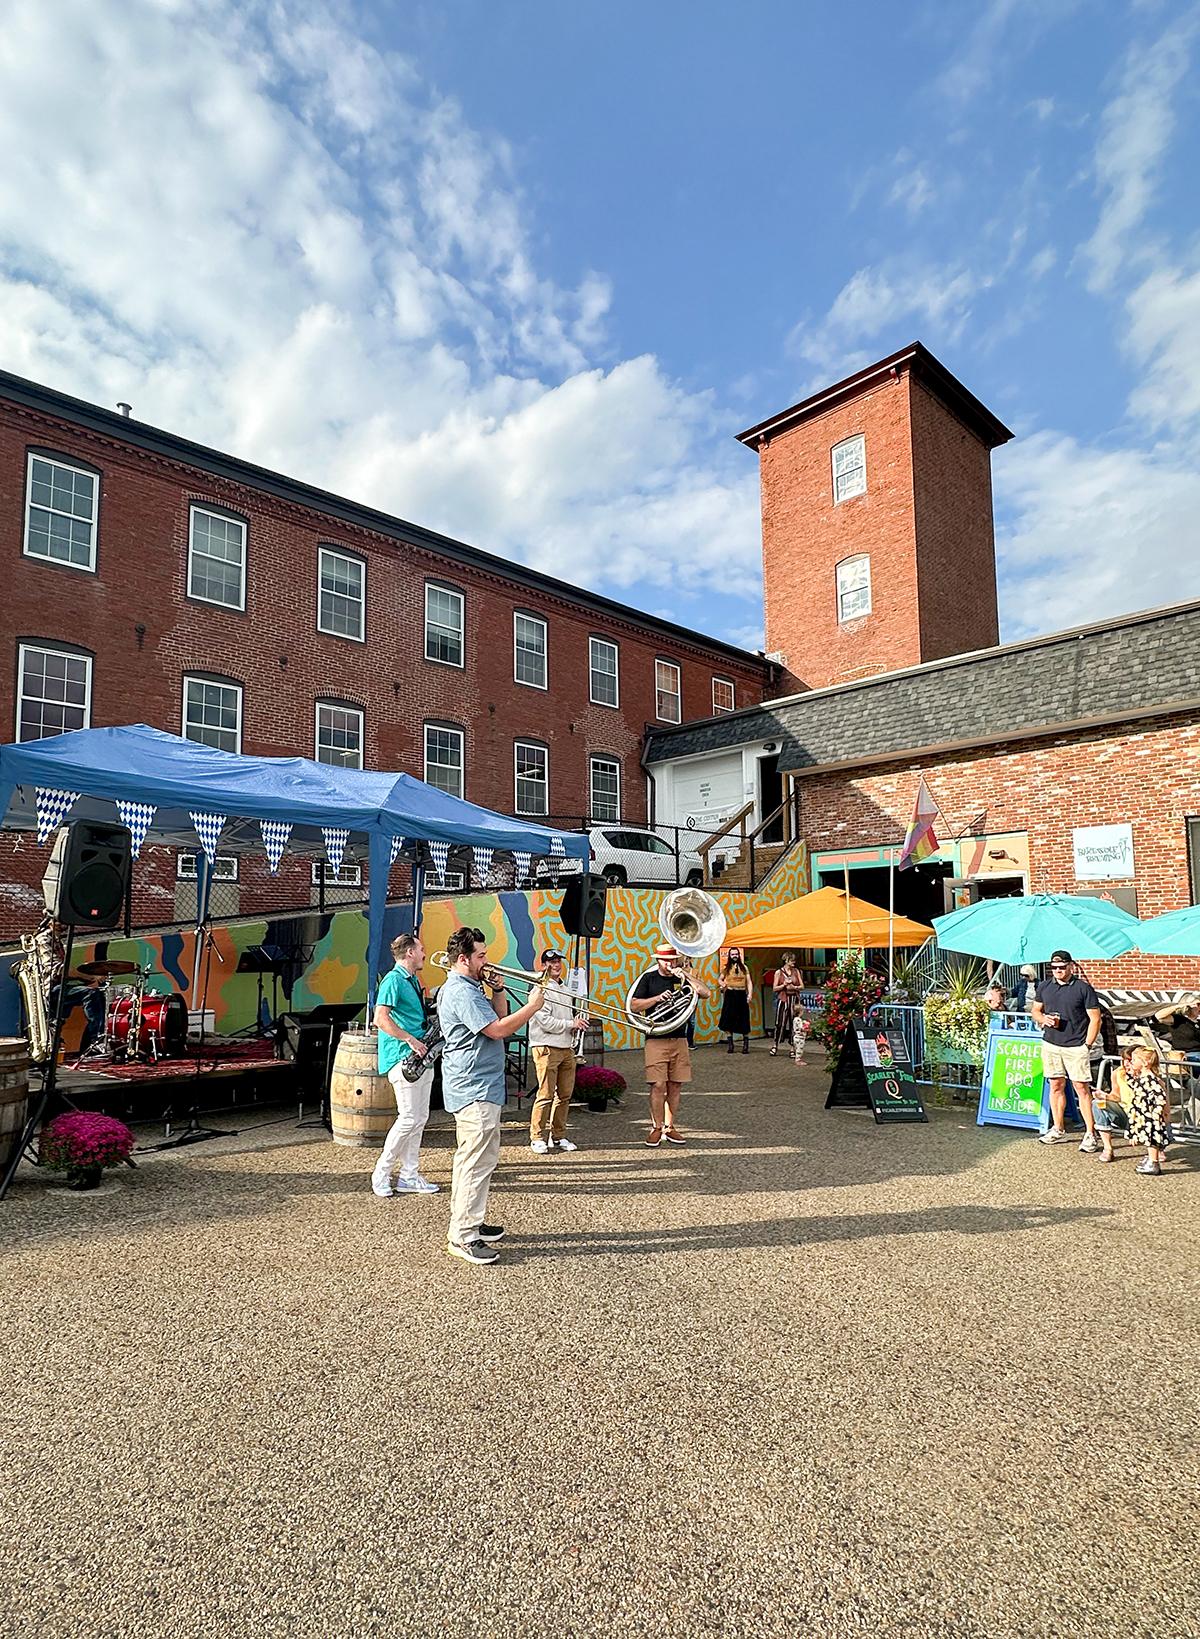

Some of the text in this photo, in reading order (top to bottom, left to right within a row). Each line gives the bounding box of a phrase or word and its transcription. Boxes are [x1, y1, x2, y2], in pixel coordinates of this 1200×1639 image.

[997, 1042, 1042, 1058] SCARLE
[1005, 1059, 1033, 1072] FIRE
[866, 1071, 895, 1085] SCARLET
[1005, 1072, 1034, 1088] BBQ
[885, 1079, 903, 1099] Q
[1009, 1087, 1020, 1099] IS
[991, 1097, 1035, 1114] INSIDE
